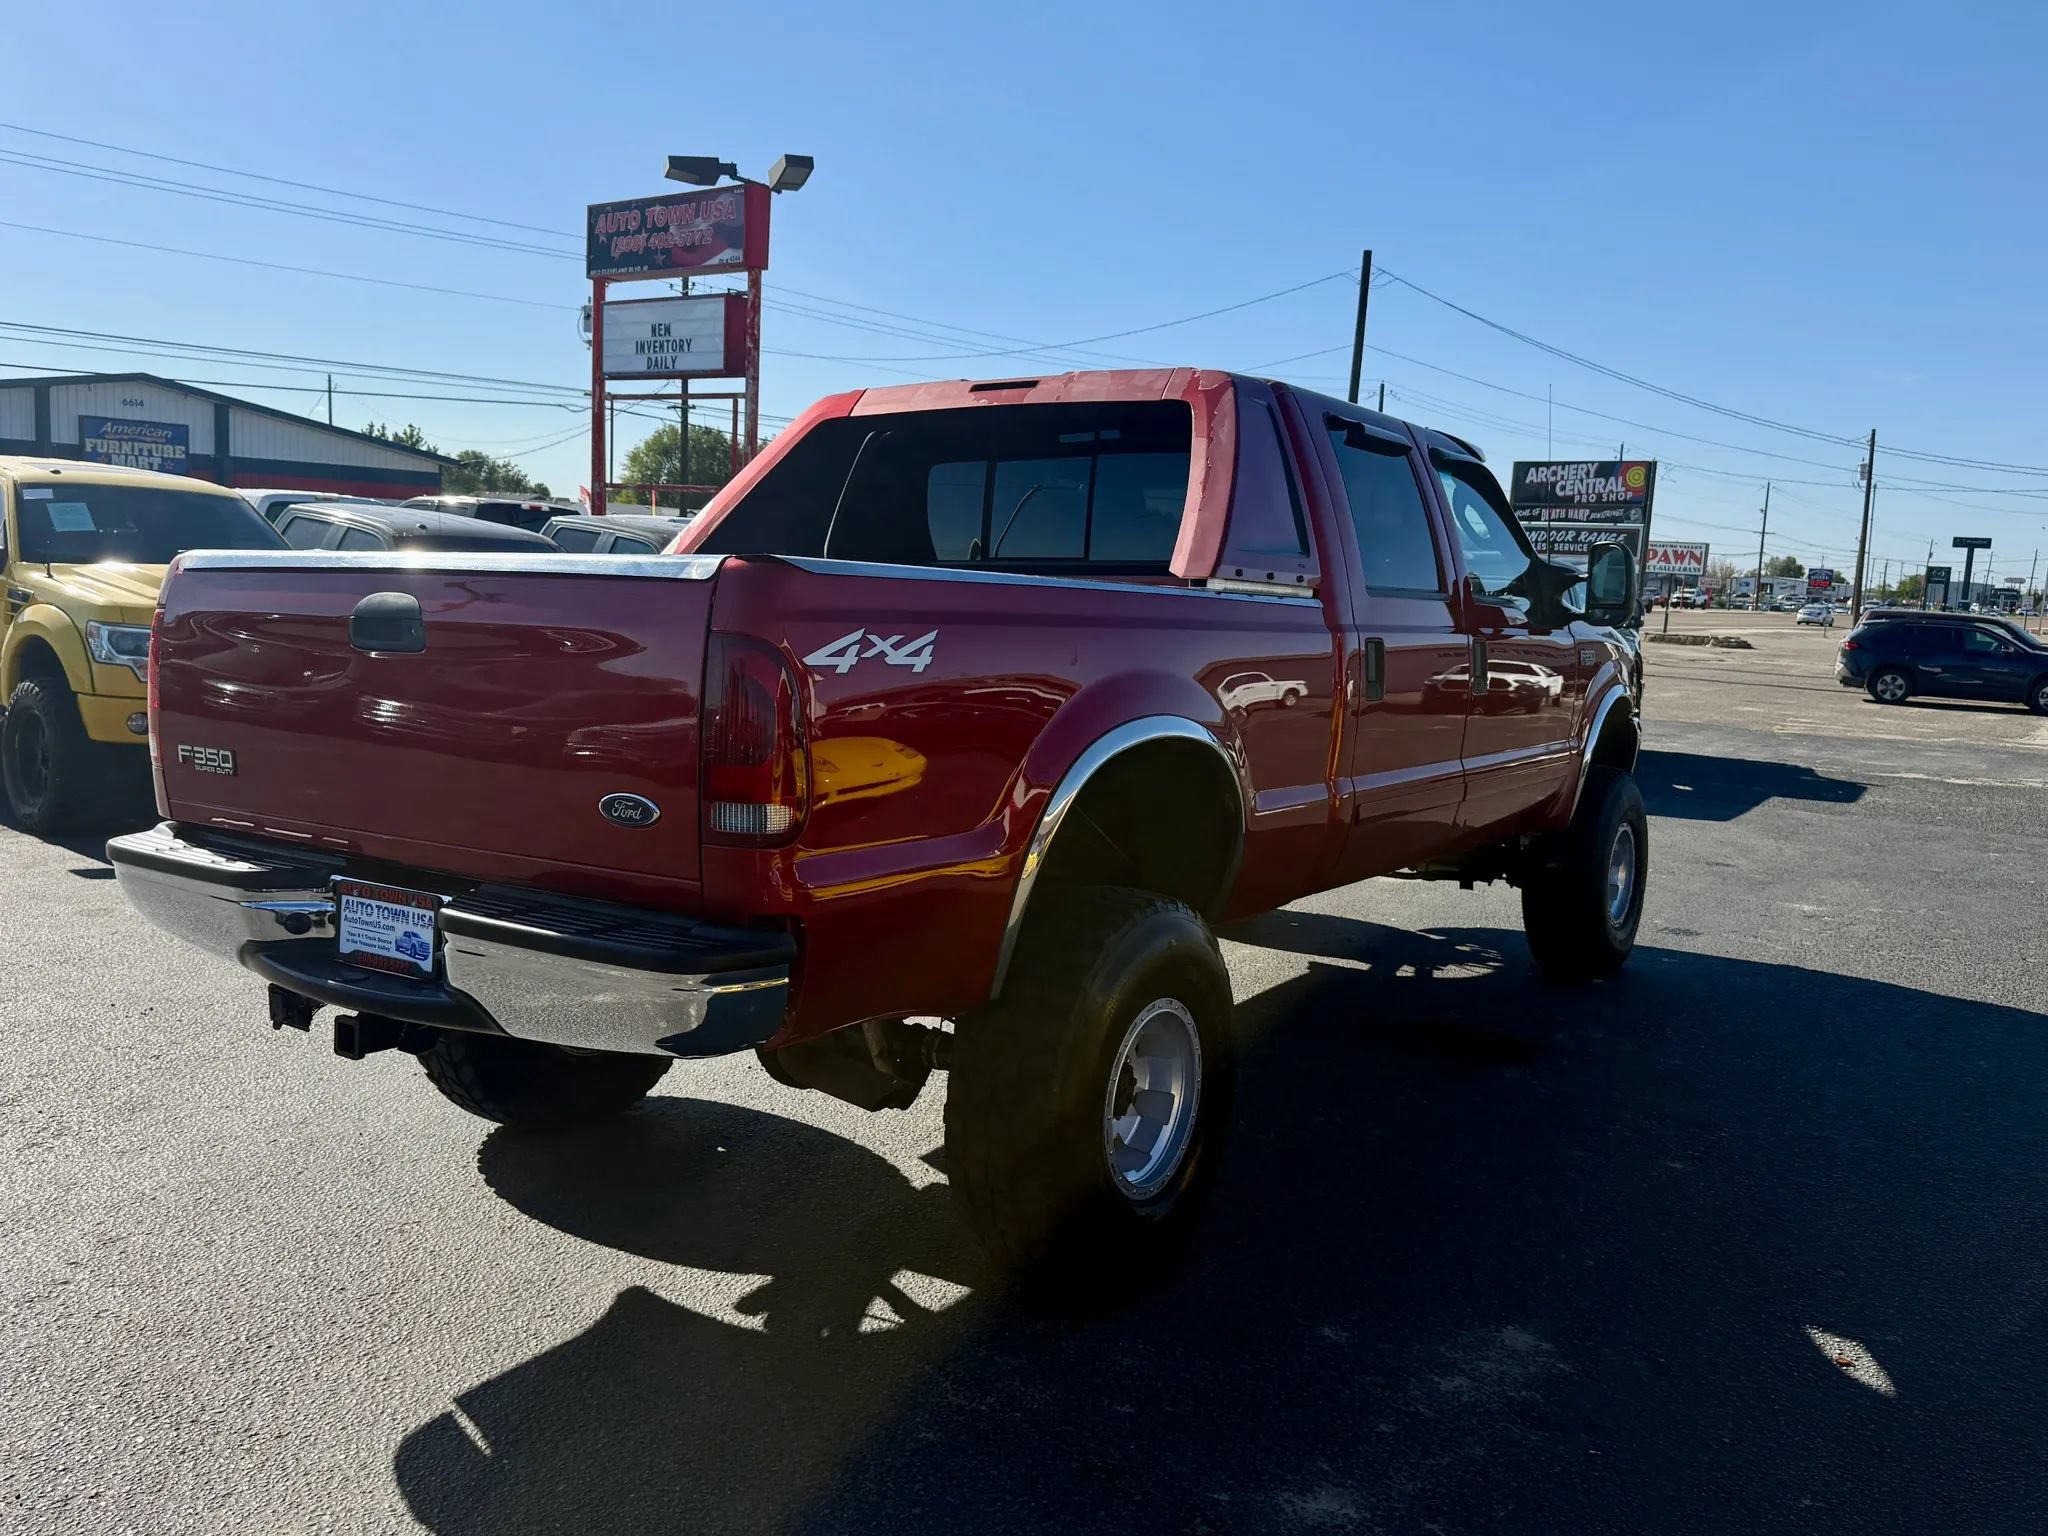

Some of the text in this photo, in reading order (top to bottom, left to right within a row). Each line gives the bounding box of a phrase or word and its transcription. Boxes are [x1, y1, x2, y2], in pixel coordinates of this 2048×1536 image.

[594, 198, 737, 234] AUTO TOWN USA
[611, 233, 645, 257] (208)
[651, 322, 671, 338] NEW
[635, 338, 692, 355] INVENTORY
[647, 355, 678, 370] DAILY
[99, 421, 173, 439] American
[84, 438, 186, 459] FURNITURE
[111, 454, 162, 471] MART
[1525, 463, 1600, 484] ARCHERY
[1555, 476, 1626, 497] CENTRAL
[1573, 491, 1633, 504] PRO SHOP
[1567, 508, 1590, 521] HARP
[1527, 530, 1576, 542] NDOOR
[1553, 542, 1588, 552] SERVICE
[1647, 548, 1703, 567] PAWN
[194, 764, 233, 775] SUPER DUTY
[611, 799, 642, 820] Ford
[343, 898, 435, 930] AUTO TOWN USA
[343, 914, 396, 932] AutoTownUS.com
